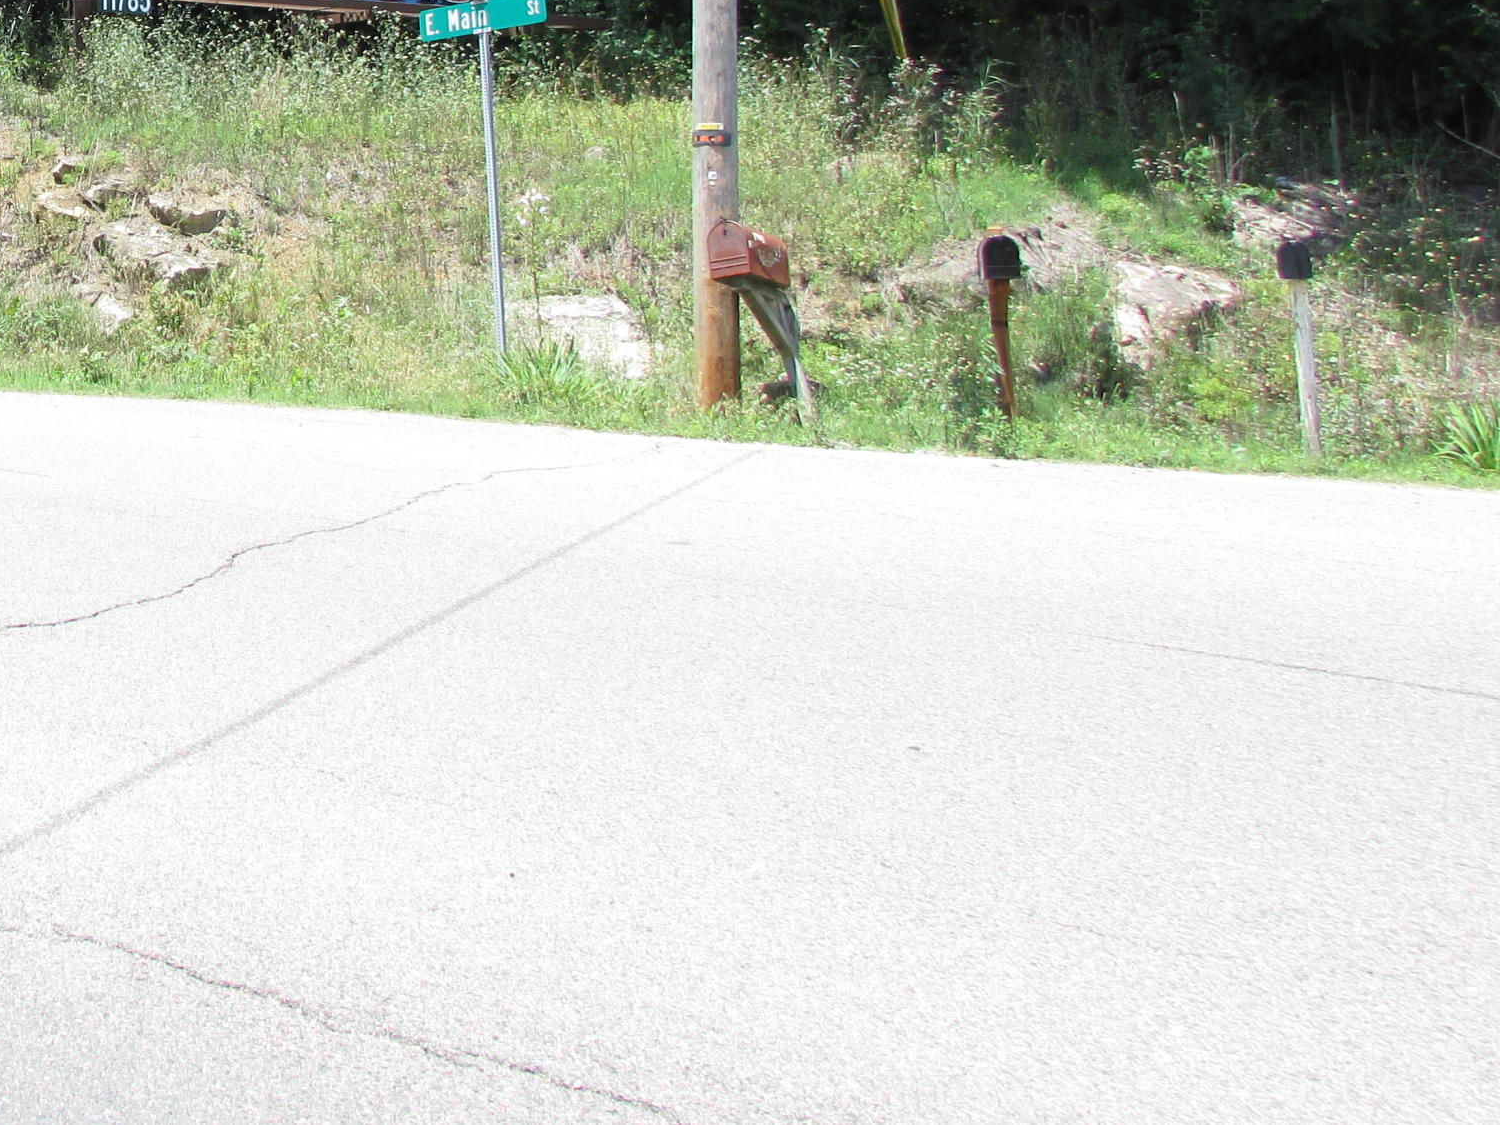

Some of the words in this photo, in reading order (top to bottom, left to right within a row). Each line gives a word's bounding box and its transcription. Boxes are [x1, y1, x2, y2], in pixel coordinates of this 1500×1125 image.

[424, 13, 440, 36] E.
[447, 7, 488, 32] Main
[526, 0, 540, 15] St
